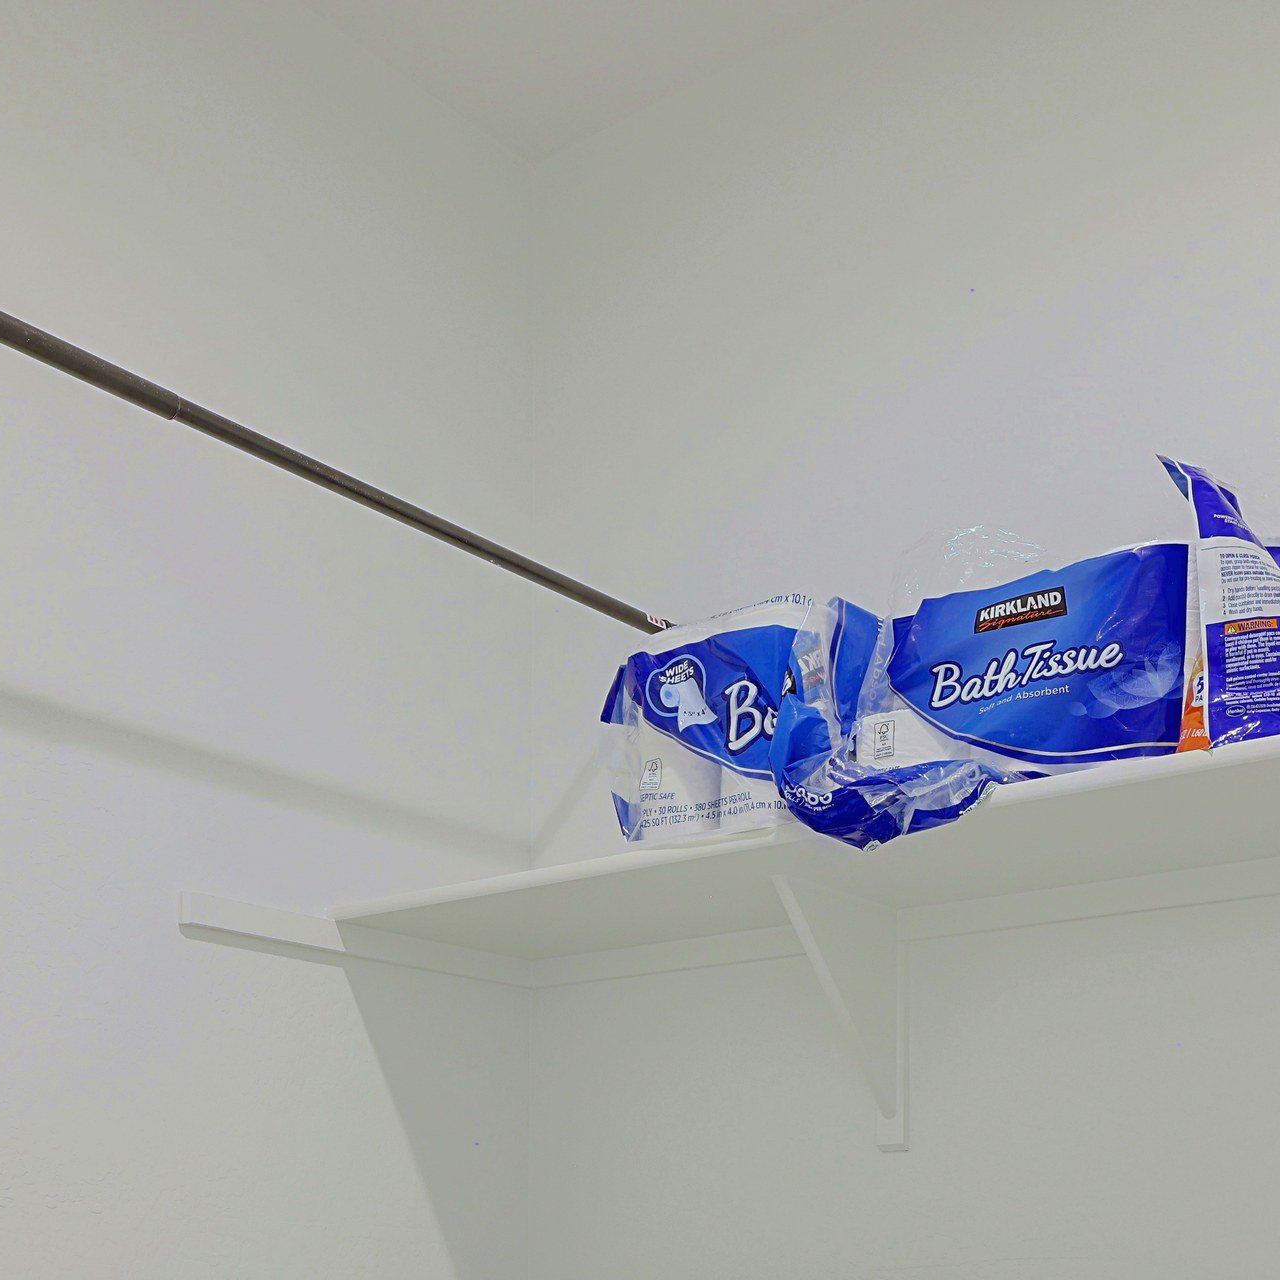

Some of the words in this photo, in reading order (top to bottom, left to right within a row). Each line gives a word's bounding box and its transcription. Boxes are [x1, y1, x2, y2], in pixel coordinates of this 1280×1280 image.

[791, 593, 806, 605] 10.1
[979, 590, 1063, 622] KIRKLAND
[977, 607, 1064, 632] Signature
[1237, 620, 1273, 632] WARNING:
[659, 666, 694, 684] SHEETS
[665, 659, 689, 677] WIDE
[931, 651, 1022, 708] Bath
[1020, 641, 1124, 686] Tissue
[978, 701, 996, 715] Soft
[997, 695, 1013, 707] and
[1014, 684, 1070, 700] Absorbent
[658, 806, 666, 815] 30
[667, 804, 688, 814] ROLLS
[693, 802, 706, 811] 380
[706, 798, 728, 811] SHEETS
[728, 795, 738, 805] PER
[738, 791, 752, 803] ROLL
[659, 792, 675, 800] SAFE
[651, 818, 660, 827] SQ
[661, 816, 668, 825] FT
[705, 810, 715, 820] 4.5
[728, 806, 738, 816] 4.0
[755, 802, 765, 810] cm
